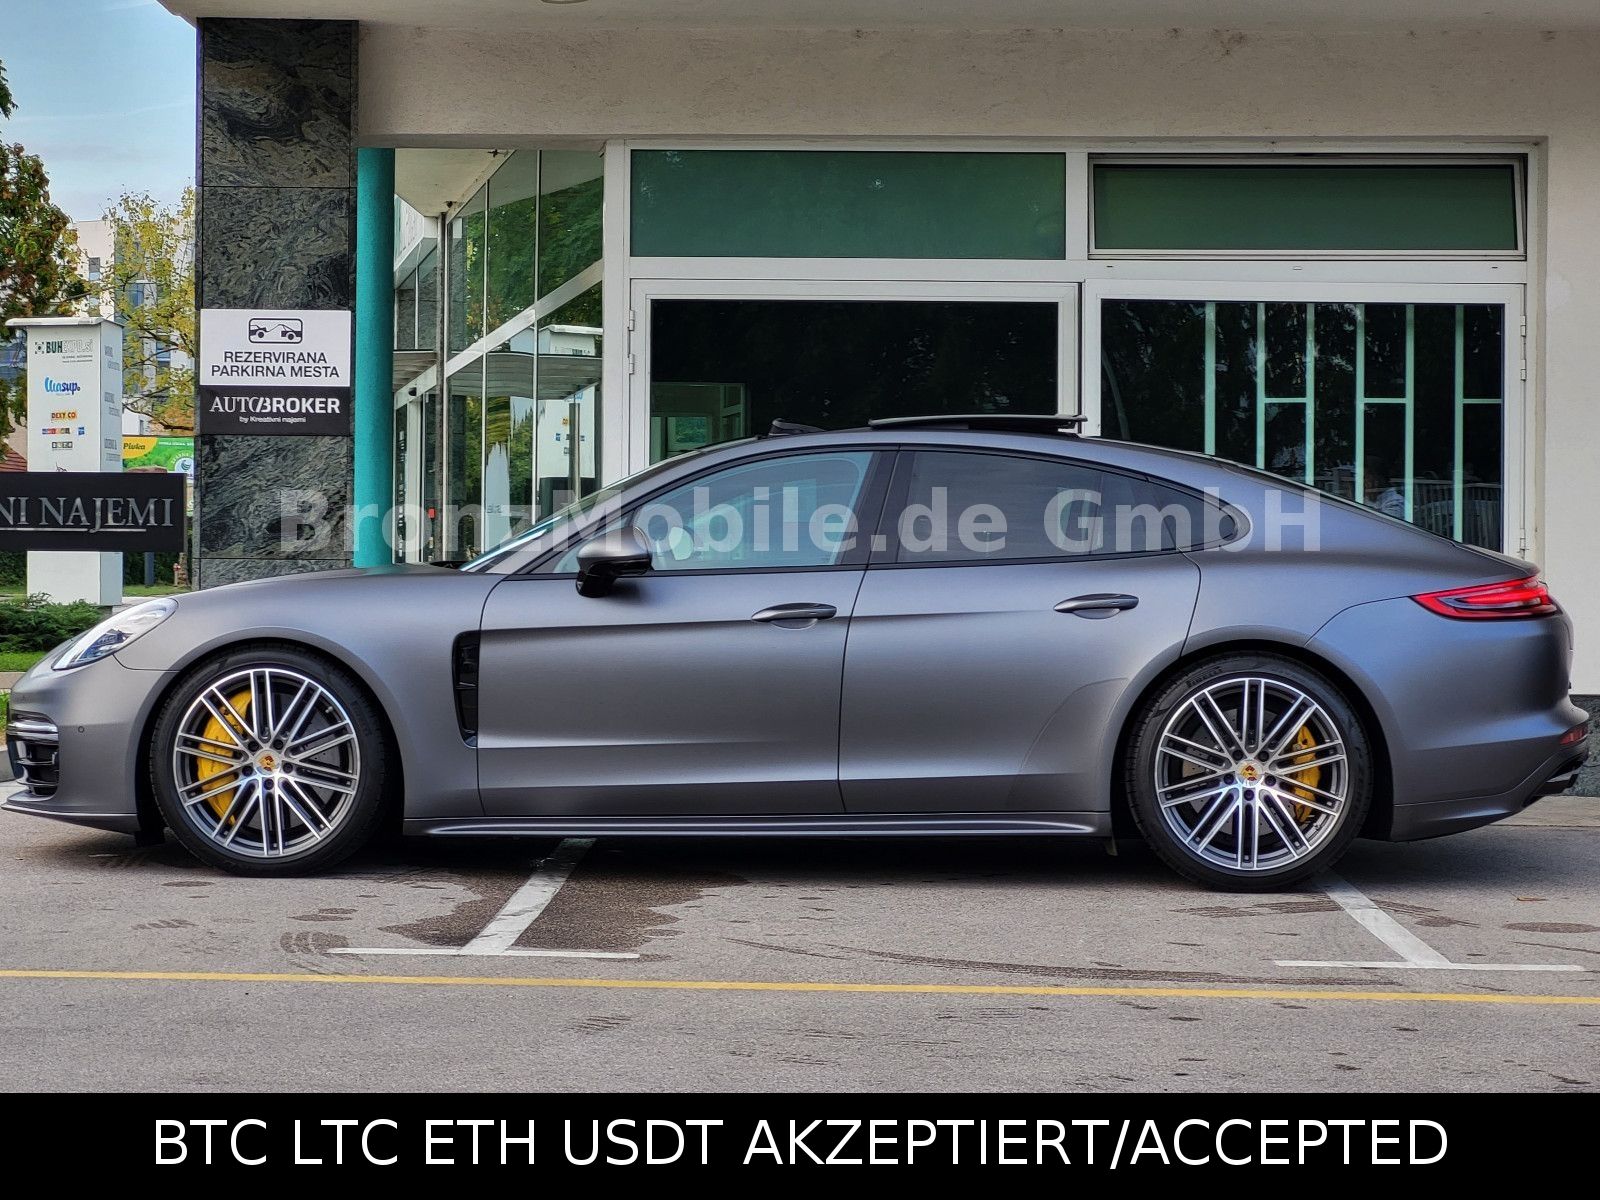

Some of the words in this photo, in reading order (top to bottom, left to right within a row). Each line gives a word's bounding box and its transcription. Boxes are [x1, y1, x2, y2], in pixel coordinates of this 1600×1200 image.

[223, 351, 328, 364] REZERVIRANA
[211, 365, 286, 377] PARKIRNA
[290, 366, 340, 378] MESTA
[38, 497, 174, 533] NAJEMI
